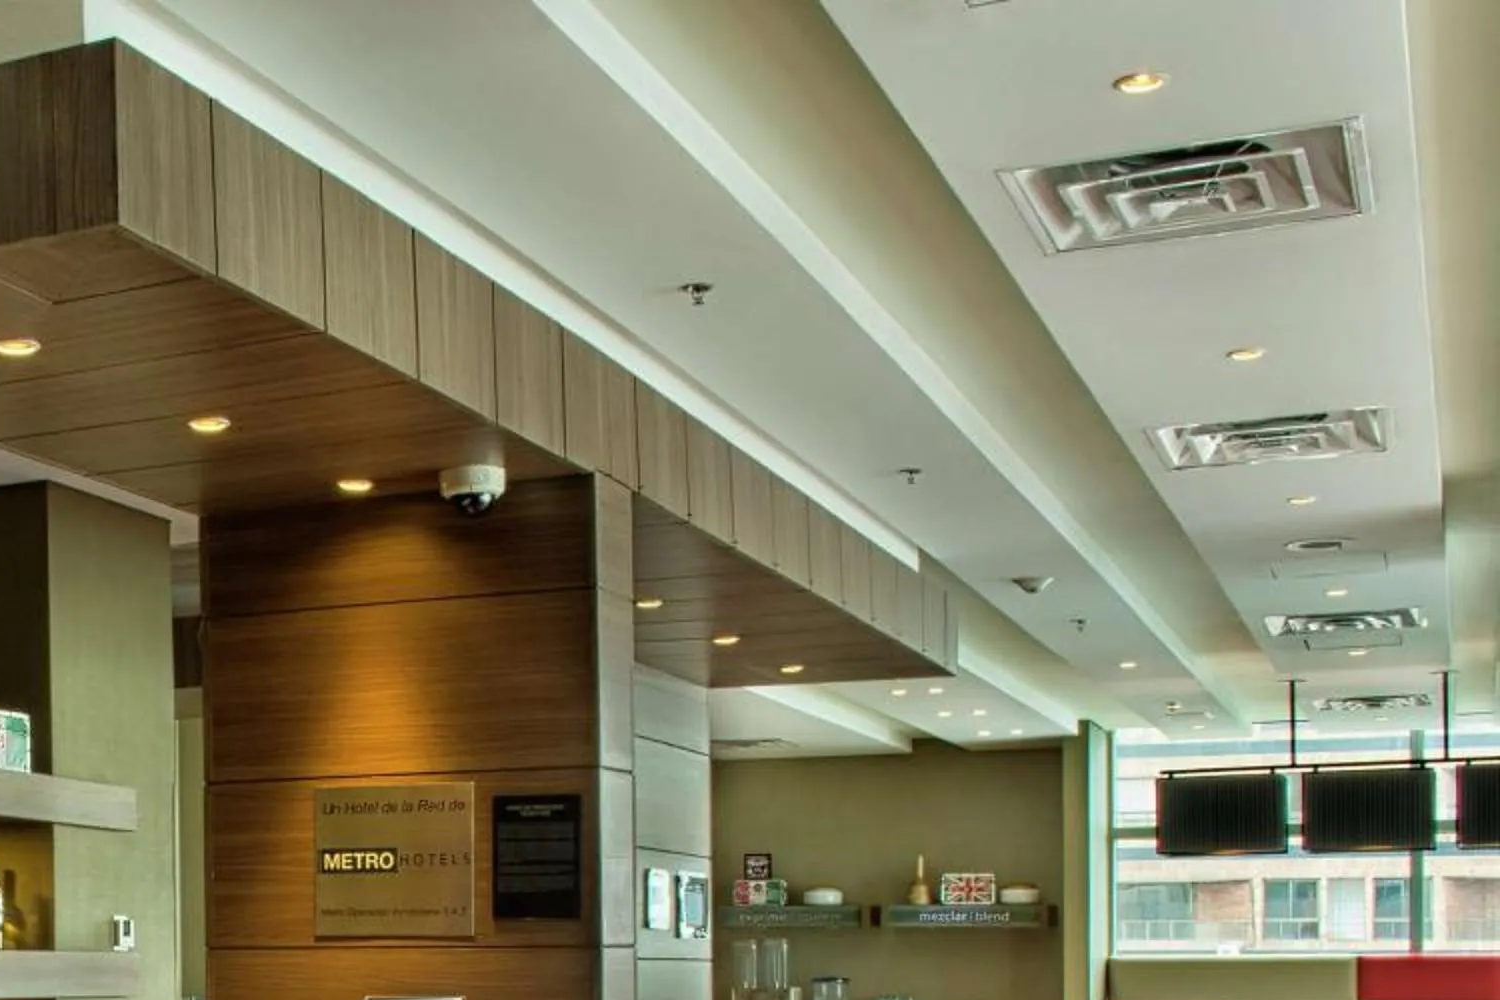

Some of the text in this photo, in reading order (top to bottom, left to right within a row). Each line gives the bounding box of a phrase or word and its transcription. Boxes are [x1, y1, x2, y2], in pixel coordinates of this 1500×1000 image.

[323, 801, 341, 815] Un
[344, 801, 379, 814] Hotel
[381, 801, 398, 814] de
[418, 799, 445, 812] Red
[323, 852, 471, 870] METRO HOTELS
[919, 911, 1010, 921] mezclar blend
